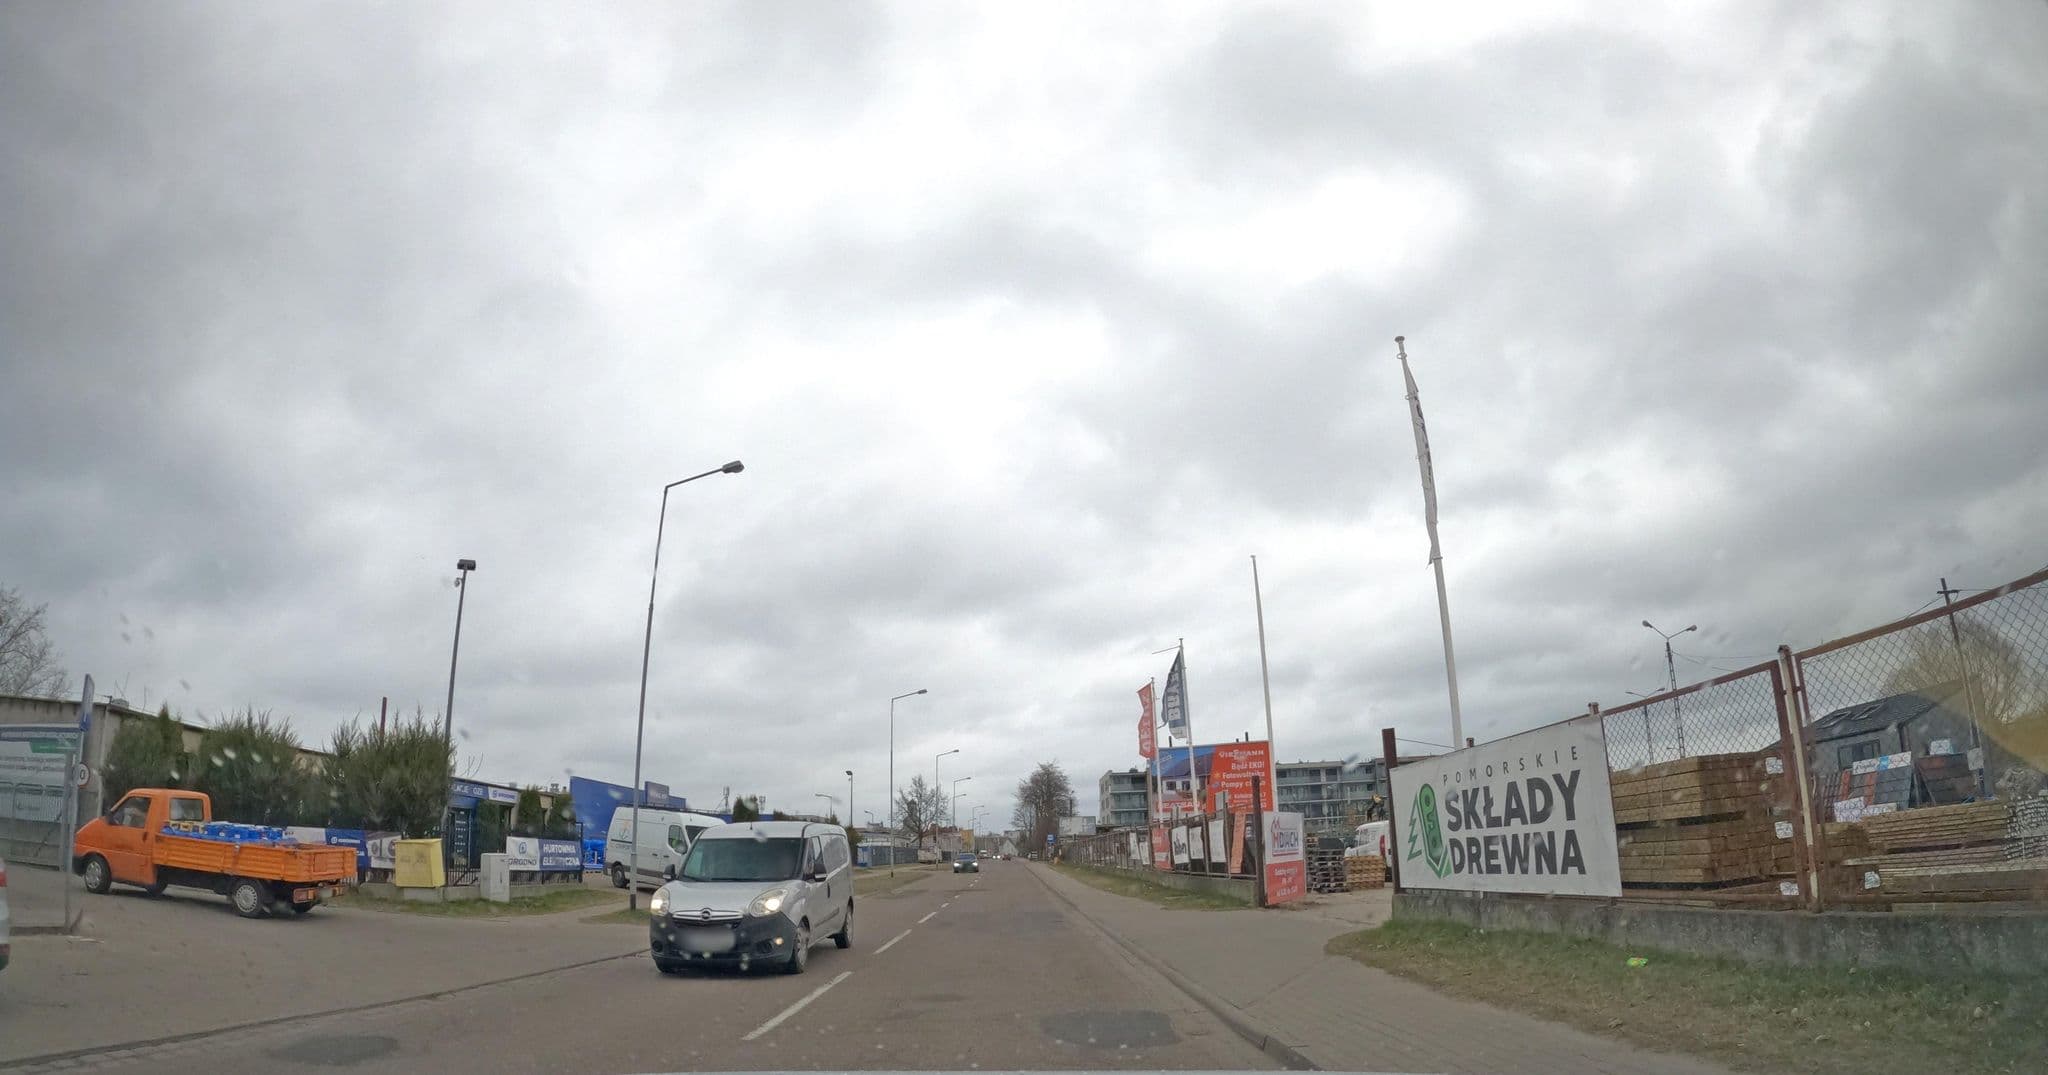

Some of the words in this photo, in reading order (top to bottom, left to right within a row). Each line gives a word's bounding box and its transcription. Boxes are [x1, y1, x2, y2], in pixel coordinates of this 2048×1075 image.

[1443, 746, 1578, 784] POMORSKIE
[1444, 769, 1581, 832] SKŁADY
[1448, 829, 1586, 875] DREWNA
